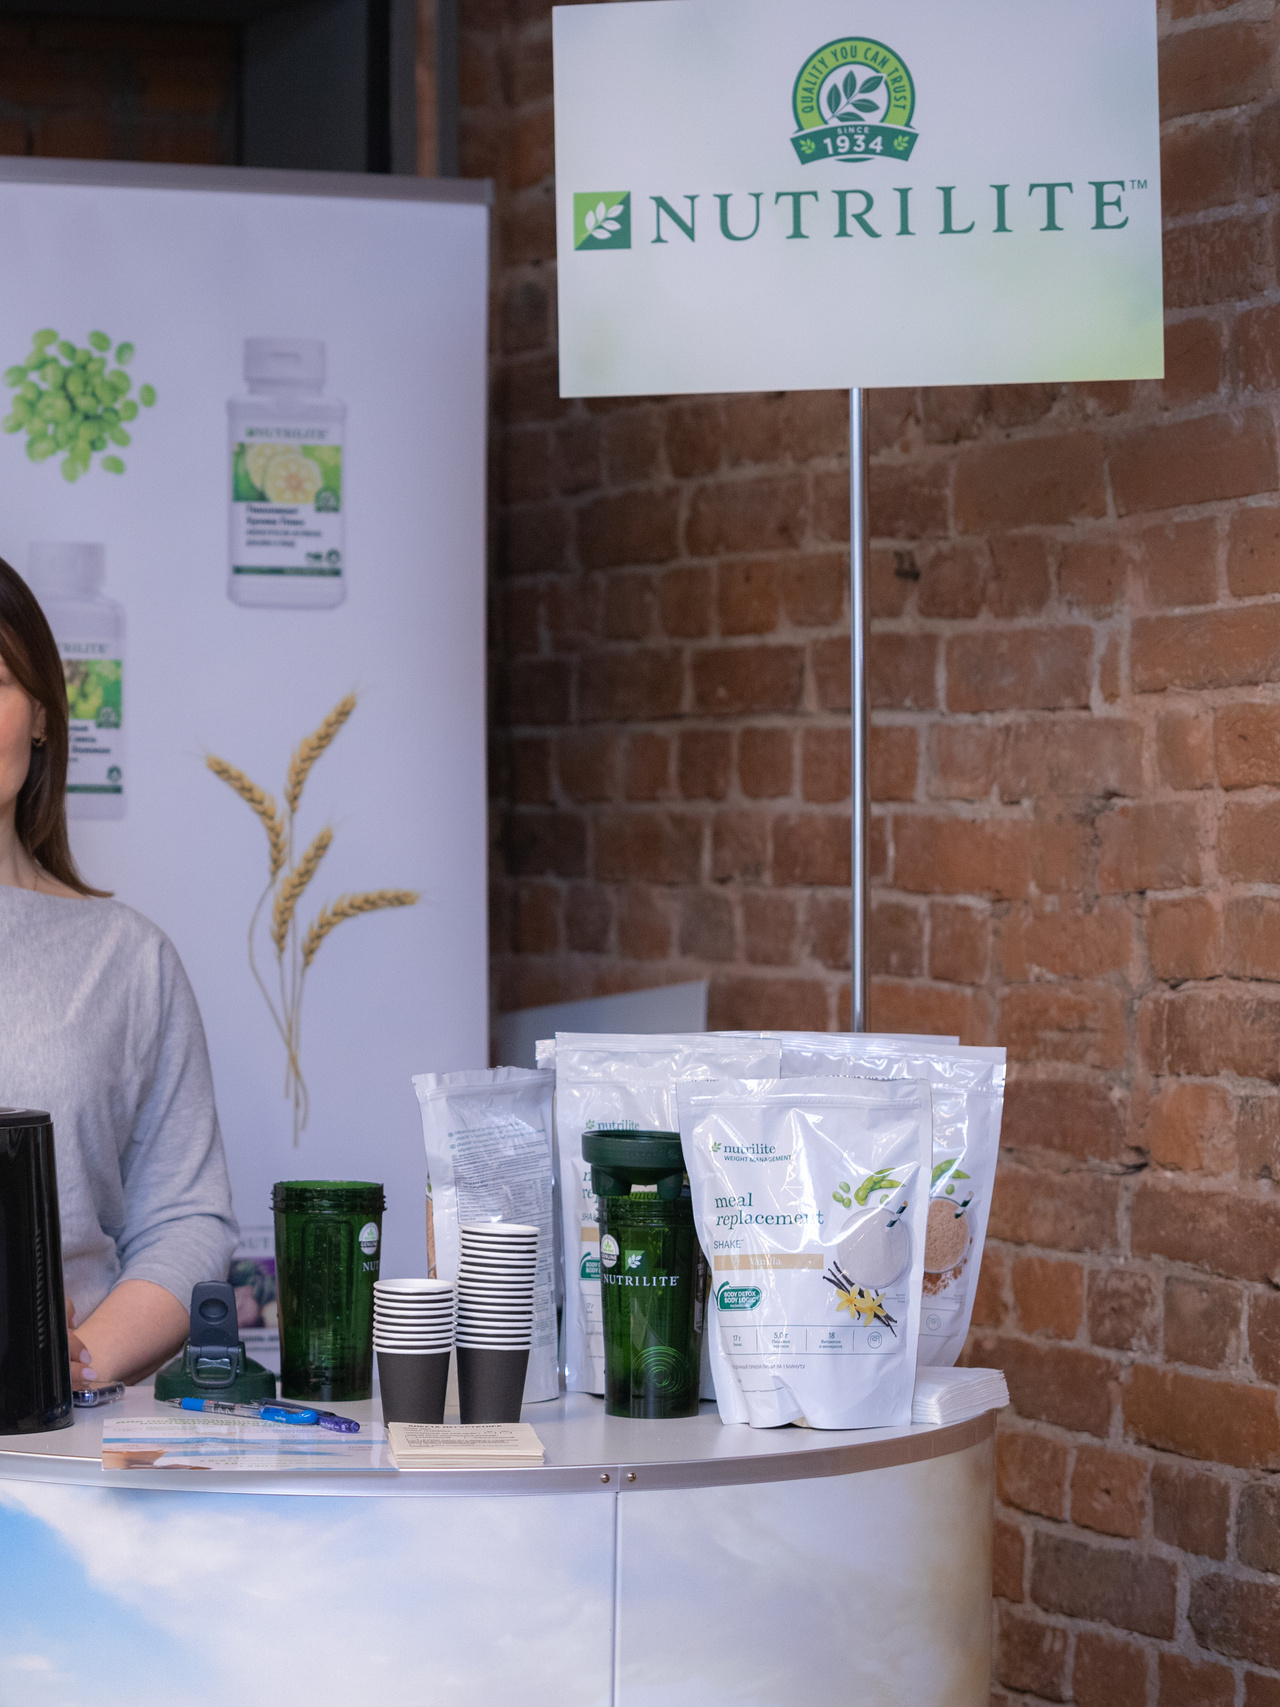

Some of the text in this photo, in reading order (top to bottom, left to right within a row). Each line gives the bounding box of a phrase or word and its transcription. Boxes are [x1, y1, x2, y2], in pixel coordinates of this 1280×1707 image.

[801, 45, 907, 114] QUALITY YOU CAN TRUST
[836, 126, 870, 135] SINCE
[823, 135, 884, 155] 1934
[597, 1119, 640, 1130] nutrilite
[723, 1143, 776, 1154] nutrilite
[724, 1155, 749, 1163] WEIGHT
[714, 1192, 754, 1208] meal
[713, 1240, 742, 1249] SHAKE
[603, 1273, 679, 1287] NUTRILITE
